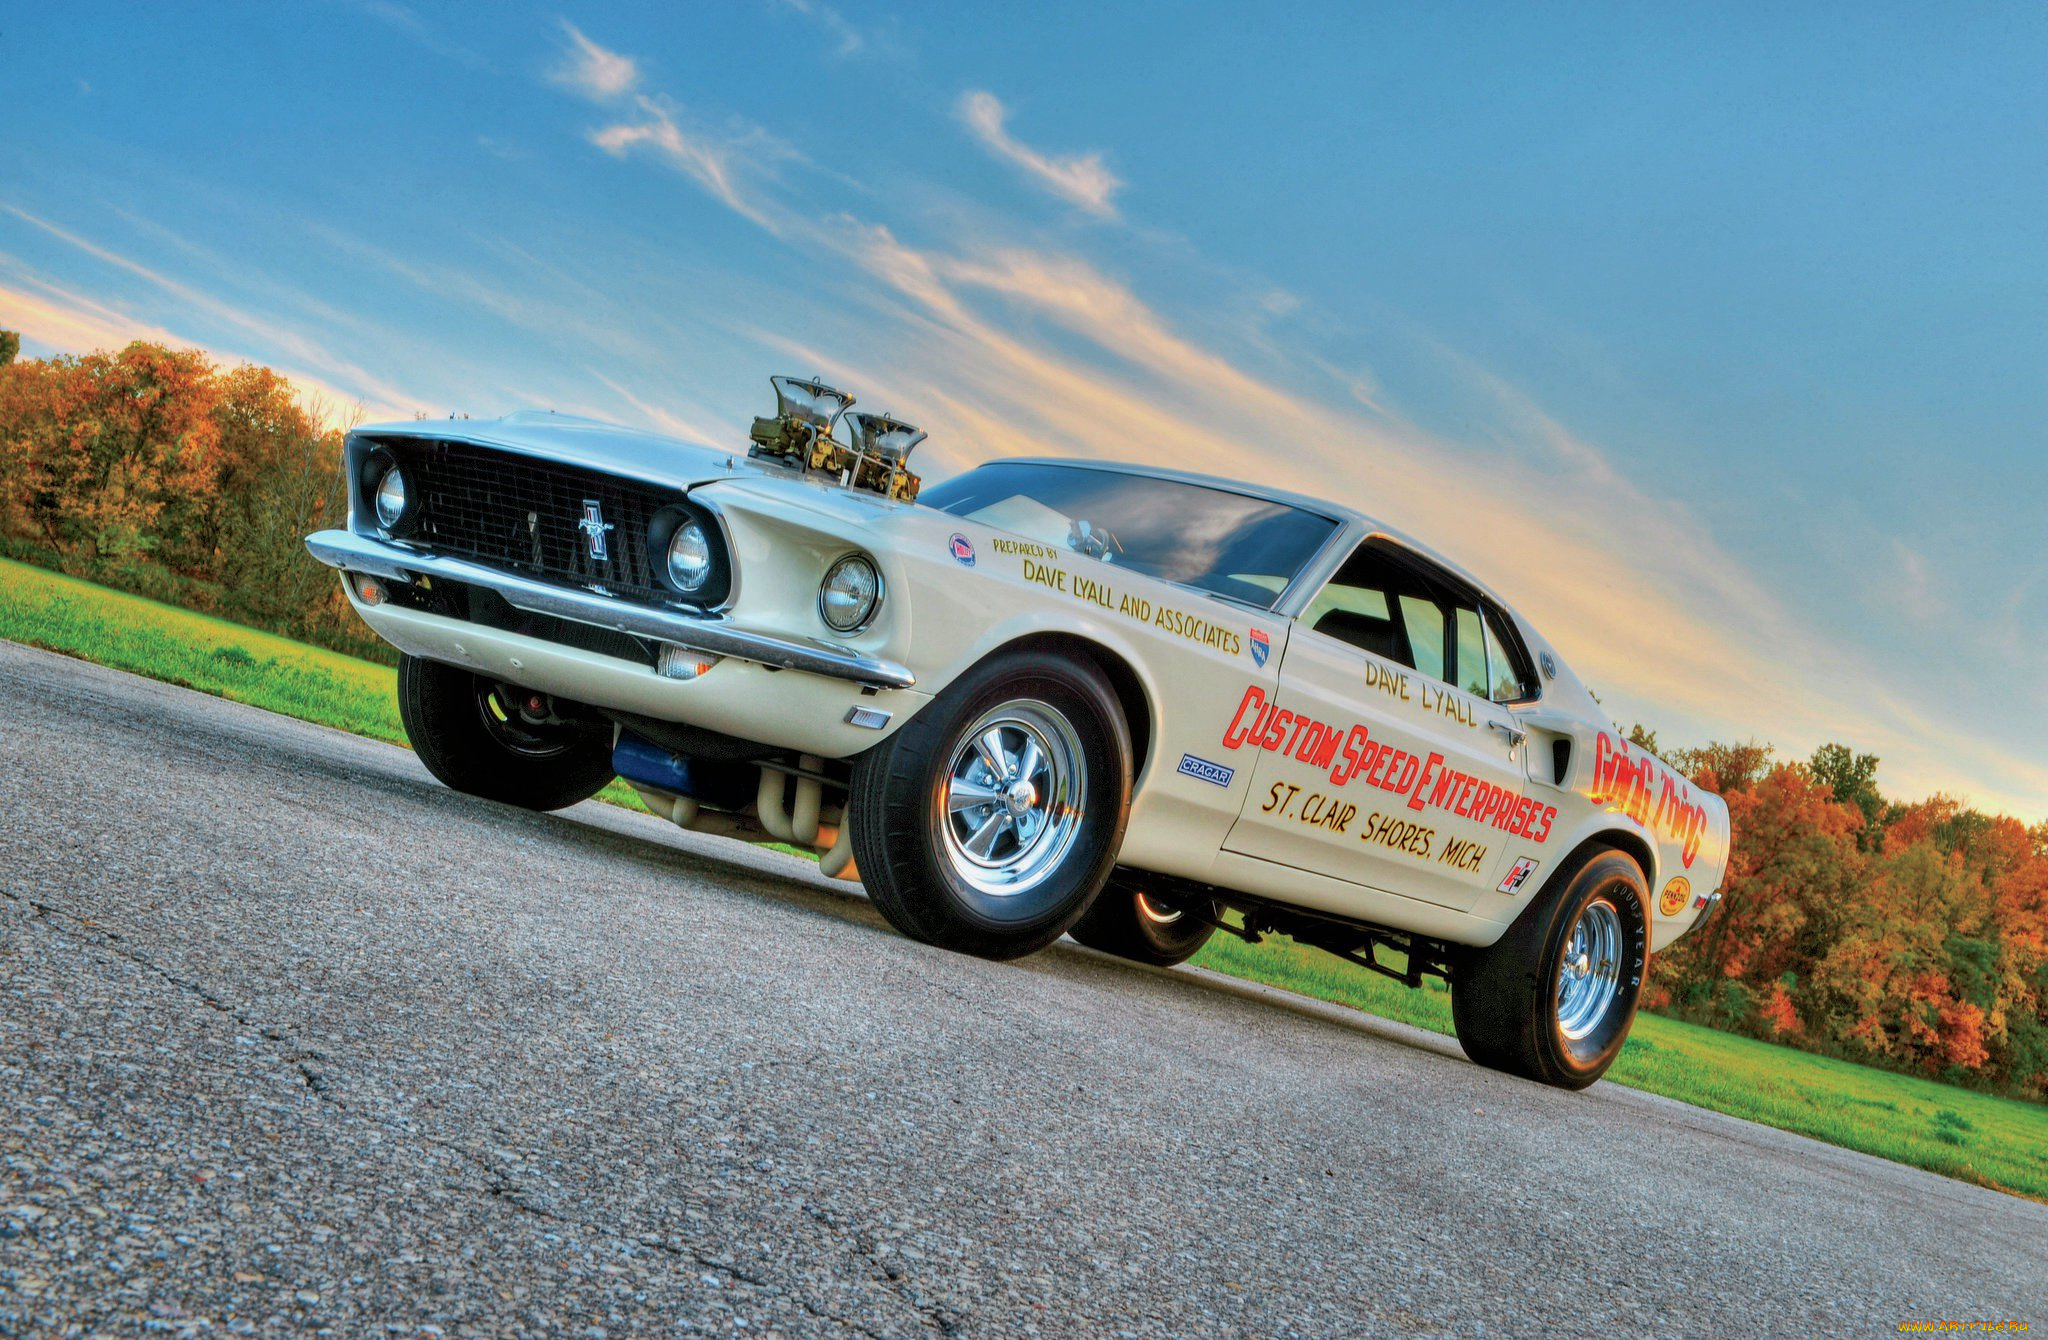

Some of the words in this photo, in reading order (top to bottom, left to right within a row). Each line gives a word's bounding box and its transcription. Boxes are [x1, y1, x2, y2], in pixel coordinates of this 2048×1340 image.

[992, 538, 1044, 557] PREPARED
[1045, 547, 1058, 559] BY
[1024, 559, 1067, 592] DAVE
[1073, 575, 1114, 609] LYALL
[1119, 593, 1151, 621] AND
[1155, 606, 1240, 655] ASSOCIATES
[1365, 660, 1409, 700] DAVE
[1422, 682, 1477, 727] LYALL
[1183, 760, 1228, 782] CRAGAR
[1222, 685, 1344, 770] CUSTOM
[1329, 724, 1420, 796] SPEED
[1407, 751, 1558, 843] ENTERPRISES
[1262, 782, 1300, 819] ST.
[1301, 794, 1357, 833] CLAIR
[1438, 836, 1487, 873] MICH.
